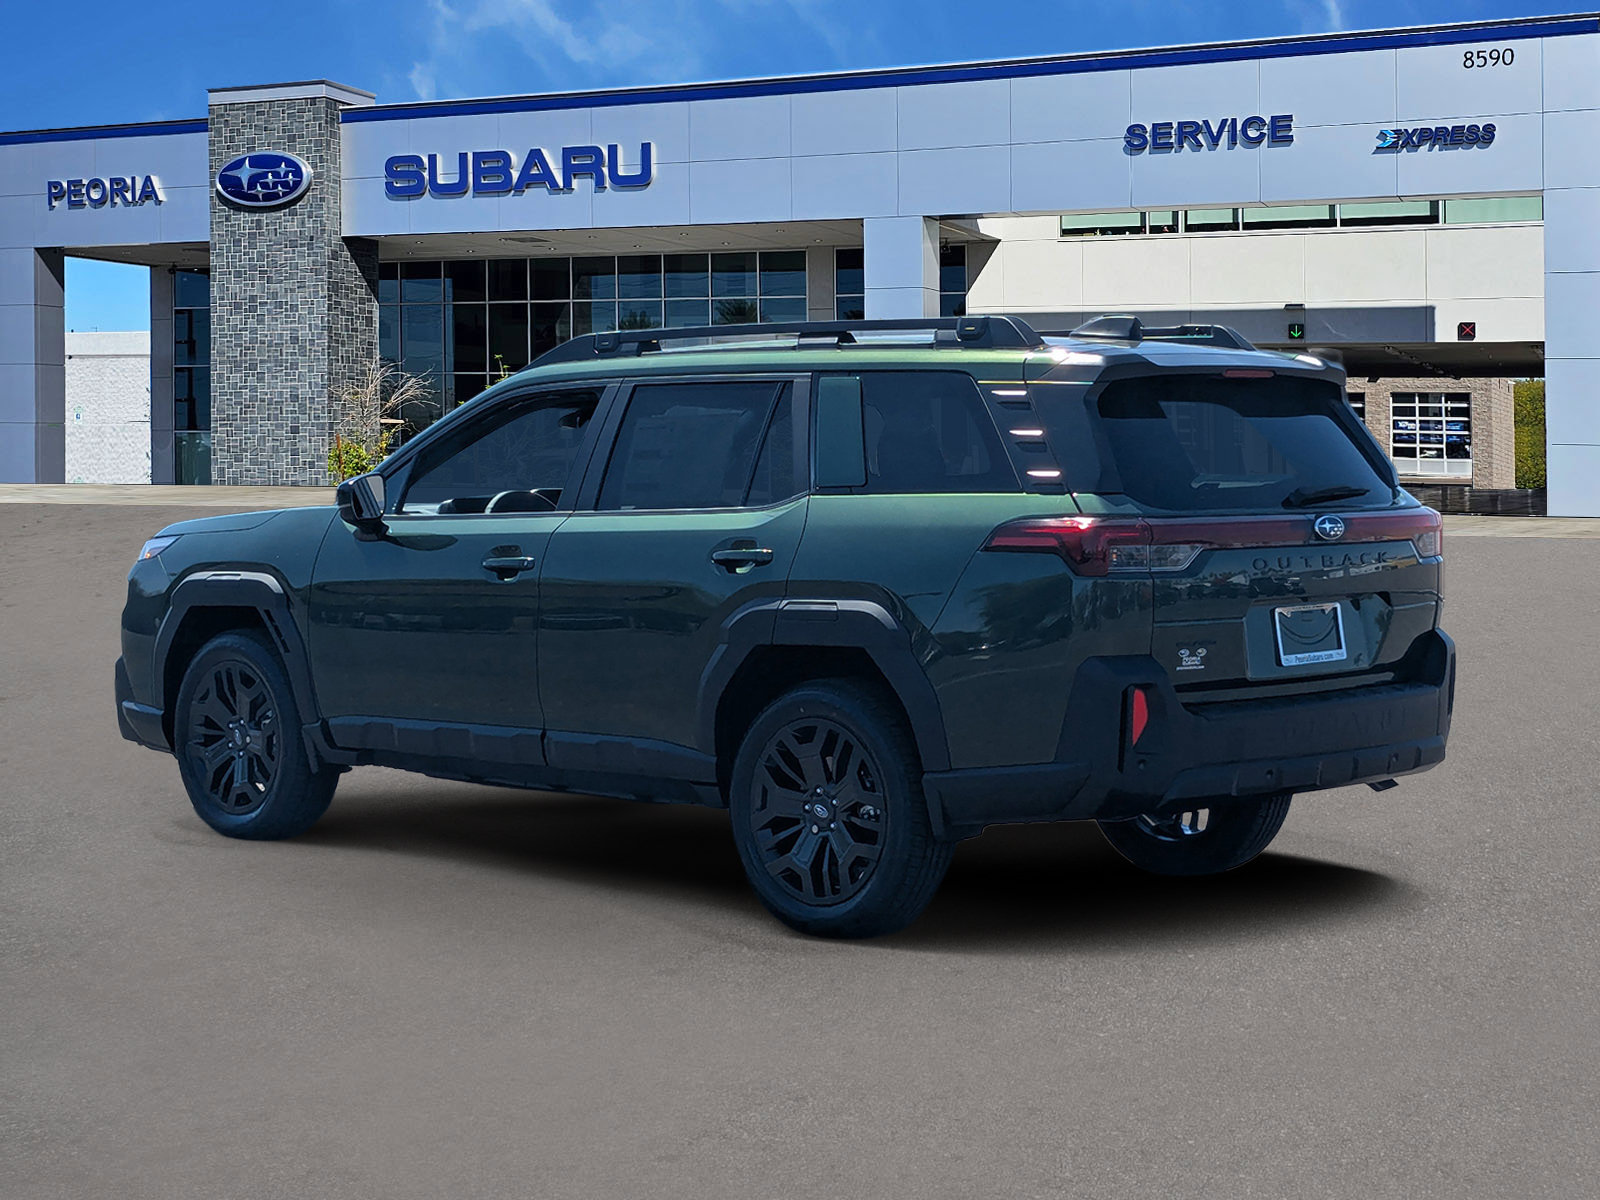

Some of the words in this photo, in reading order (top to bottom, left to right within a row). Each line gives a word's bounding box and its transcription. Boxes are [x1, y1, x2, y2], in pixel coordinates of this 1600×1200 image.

[1463, 48, 1515, 69] 8590
[1125, 114, 1294, 151] SERVICE
[1376, 123, 1497, 149] EXPRESS
[384, 141, 652, 197] SUBARU
[47, 175, 162, 208] PEORIA
[1251, 550, 1389, 571] OUTBACK
